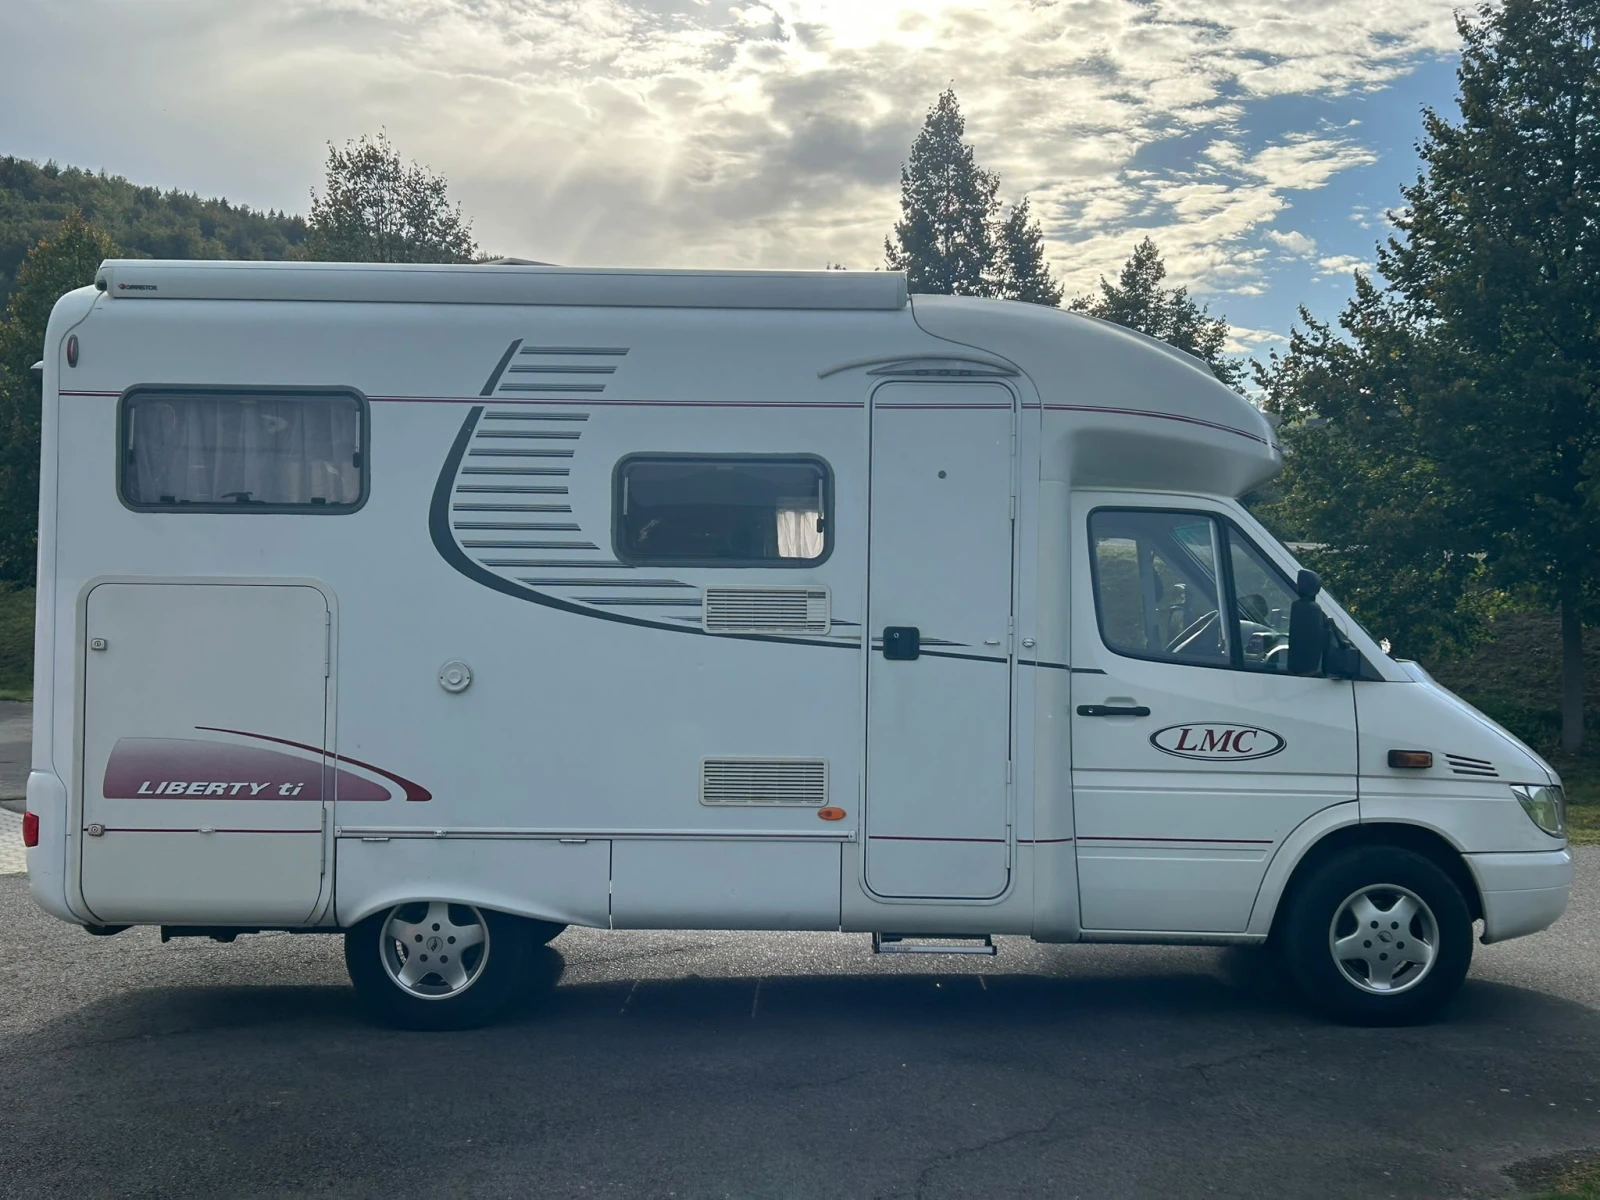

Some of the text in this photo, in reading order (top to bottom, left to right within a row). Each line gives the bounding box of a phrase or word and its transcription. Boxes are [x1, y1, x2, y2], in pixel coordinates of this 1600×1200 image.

[1174, 728, 1257, 753] LMC
[137, 781, 304, 796] LIBERTY ti
